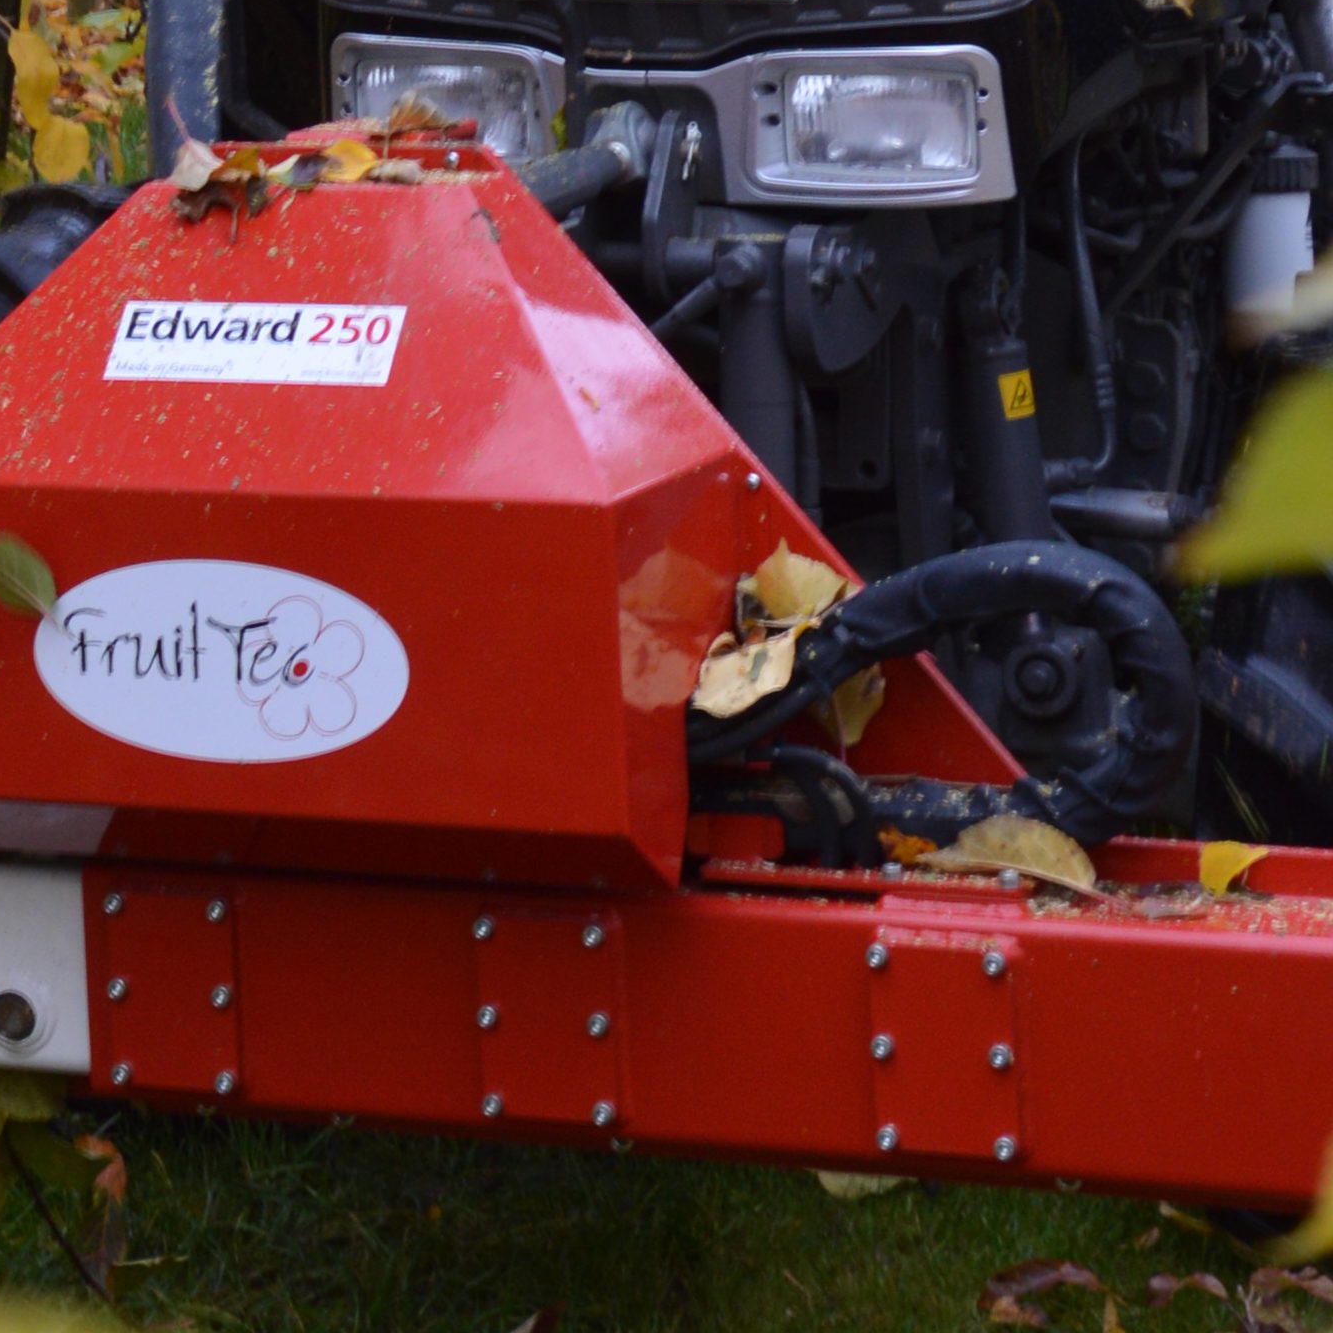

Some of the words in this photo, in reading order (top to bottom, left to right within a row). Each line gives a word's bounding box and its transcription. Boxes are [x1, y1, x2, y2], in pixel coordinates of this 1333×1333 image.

[125, 309, 302, 343] Edward
[308, 313, 392, 346] 250
[63, 599, 206, 681] Fruit
[206, 615, 315, 687] Tec
